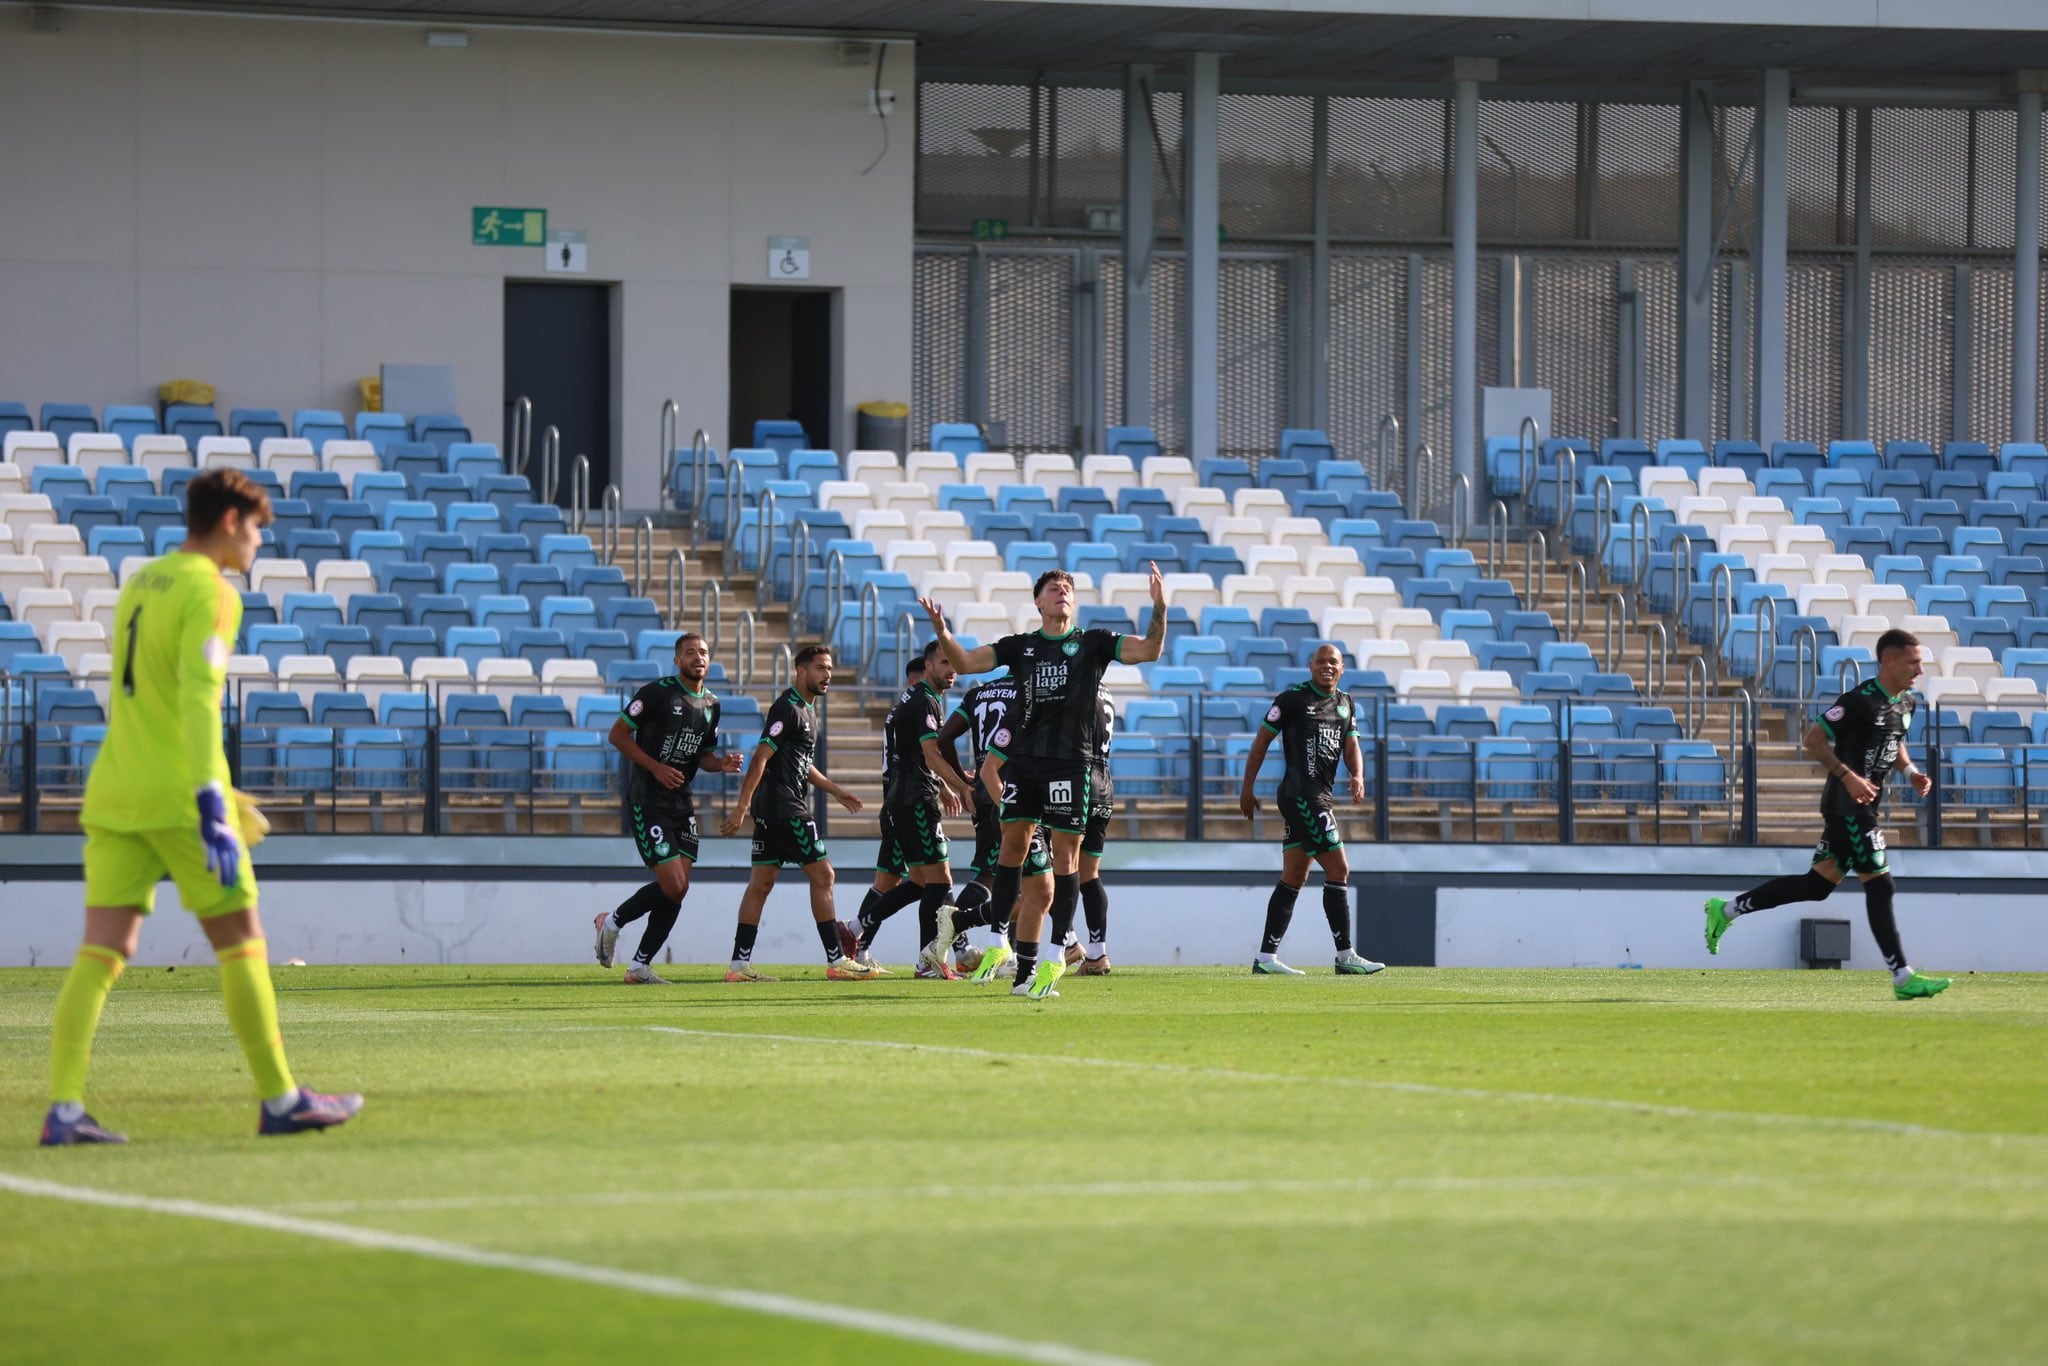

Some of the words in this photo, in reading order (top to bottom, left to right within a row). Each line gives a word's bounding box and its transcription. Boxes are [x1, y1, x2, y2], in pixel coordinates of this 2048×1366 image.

[123, 604, 143, 698] 1
[1041, 660, 1069, 677] má
[1036, 673, 1068, 691] laga
[676, 738, 698, 756] laga
[650, 825, 664, 845] 9
[806, 821, 819, 841] 7
